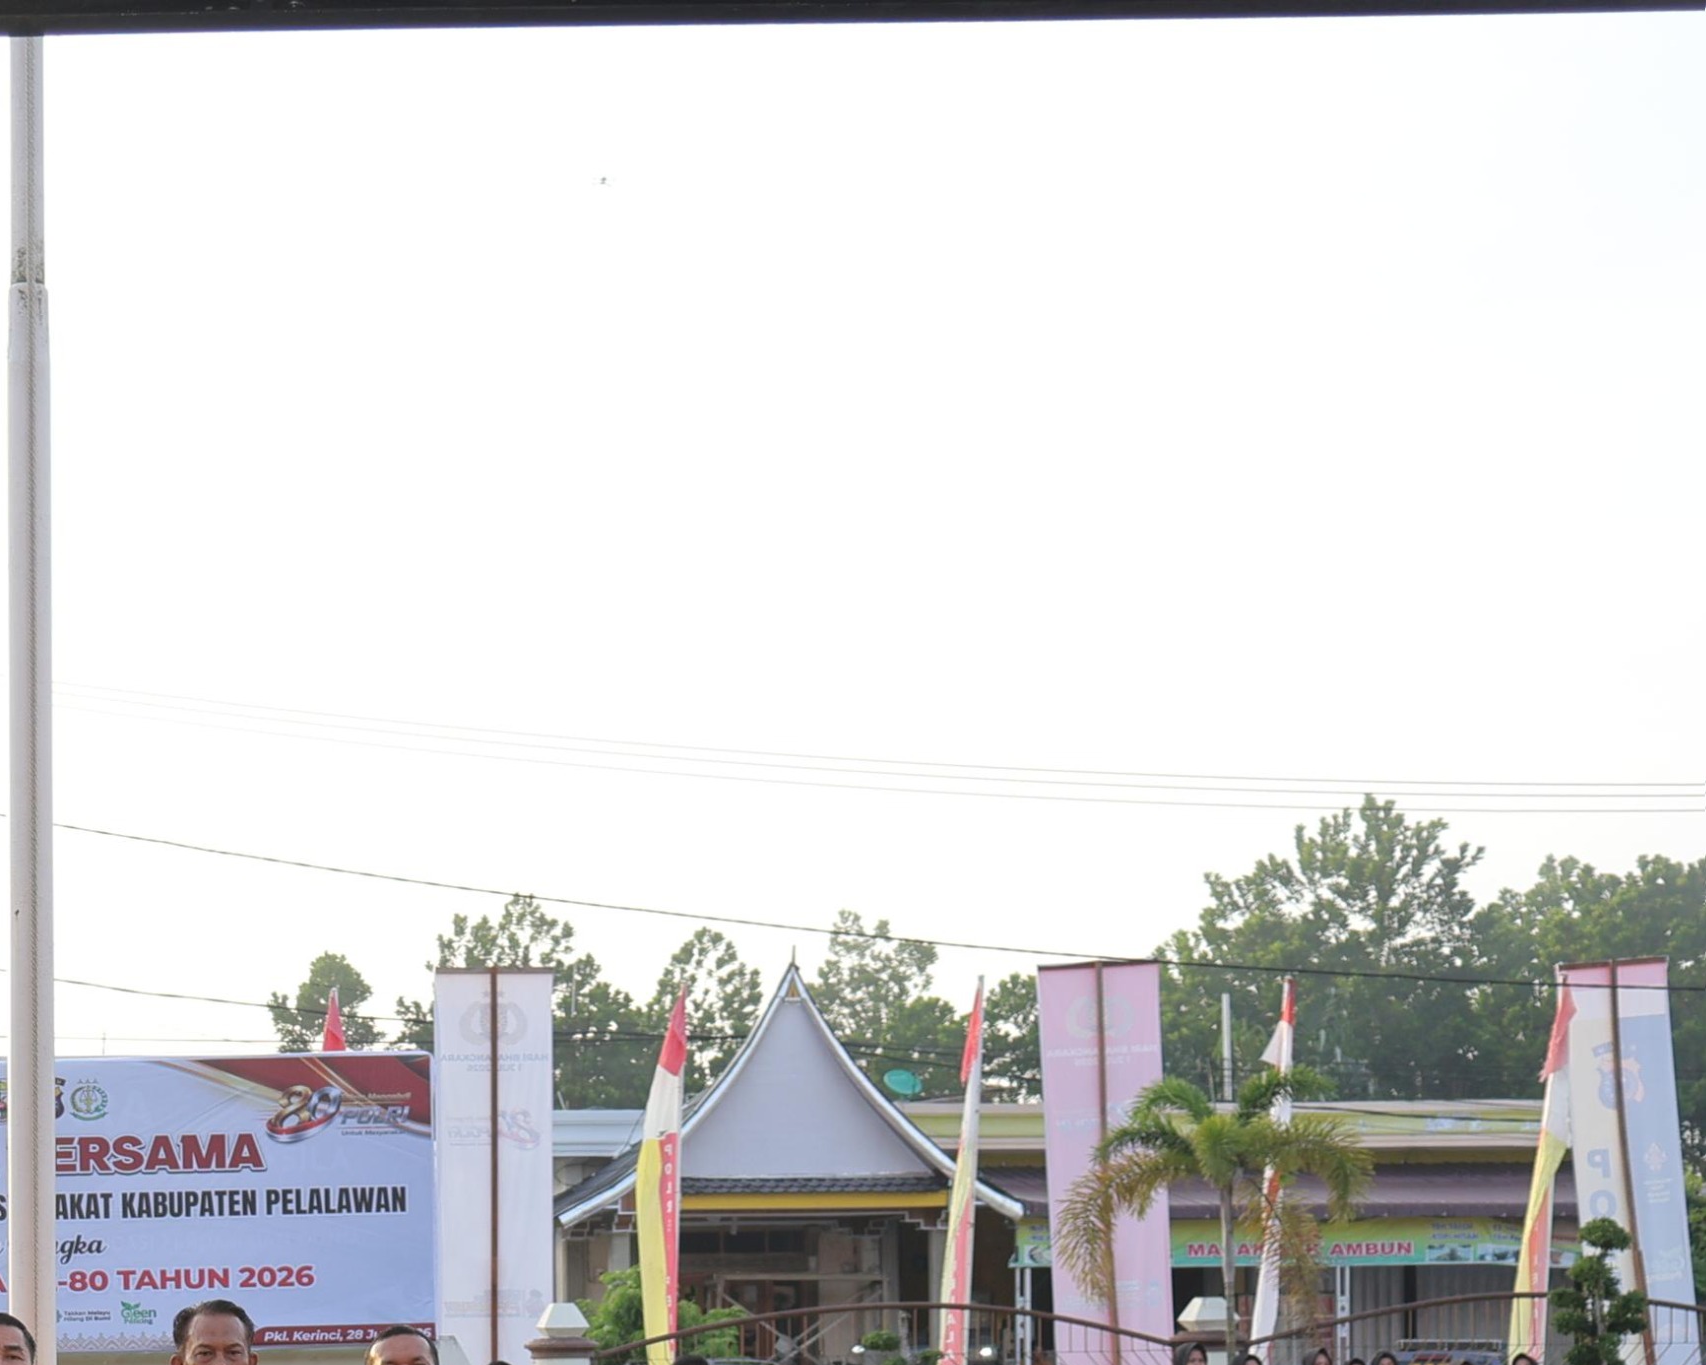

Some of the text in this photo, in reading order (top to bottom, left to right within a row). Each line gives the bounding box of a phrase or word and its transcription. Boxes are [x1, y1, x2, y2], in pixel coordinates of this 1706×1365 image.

[341, 1105, 410, 1125] POLRI
[55, 1133, 267, 1175] ERSAMA
[122, 1189, 258, 1218] KABUPATEN
[266, 1186, 407, 1215] PELALAWAN
[1330, 1241, 1412, 1257] AMBUN
[55, 1270, 109, 1292] -80
[117, 1268, 230, 1291] TAHUN
[239, 1266, 314, 1288] 2026
[264, 1331, 289, 1342] Pkl.
[294, 1329, 344, 1342] Kerinci,
[346, 1329, 364, 1340] 28
